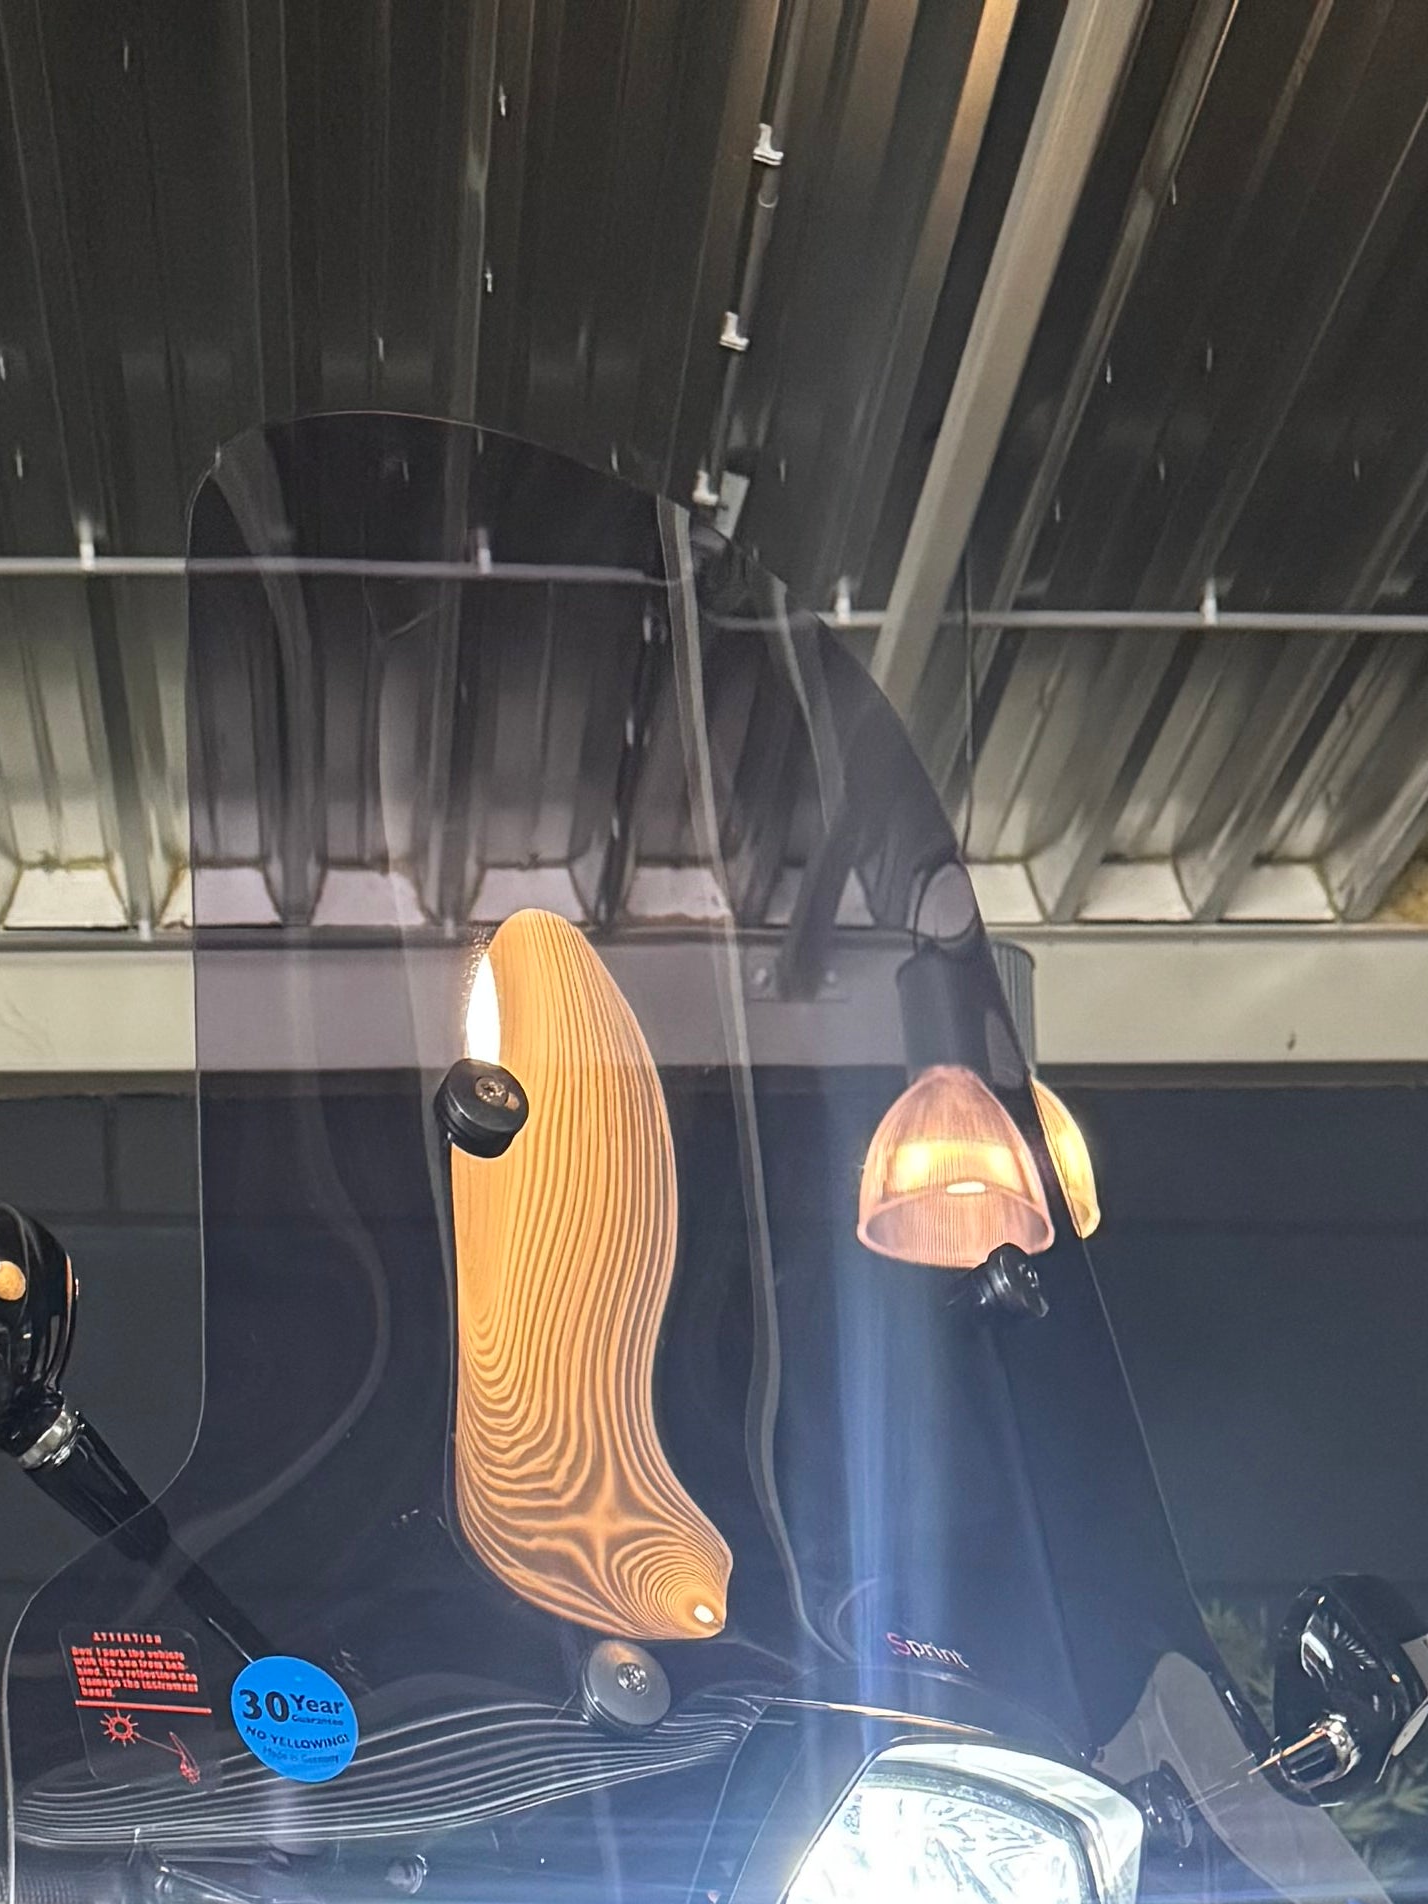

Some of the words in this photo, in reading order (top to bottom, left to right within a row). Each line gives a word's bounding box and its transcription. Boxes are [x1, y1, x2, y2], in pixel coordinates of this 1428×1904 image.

[885, 1631, 970, 1669] Sprint
[239, 1689, 290, 1723] 30
[289, 1694, 344, 1715] Year
[245, 1725, 267, 1740] NO
[270, 1733, 350, 1750] YELLOWING!
